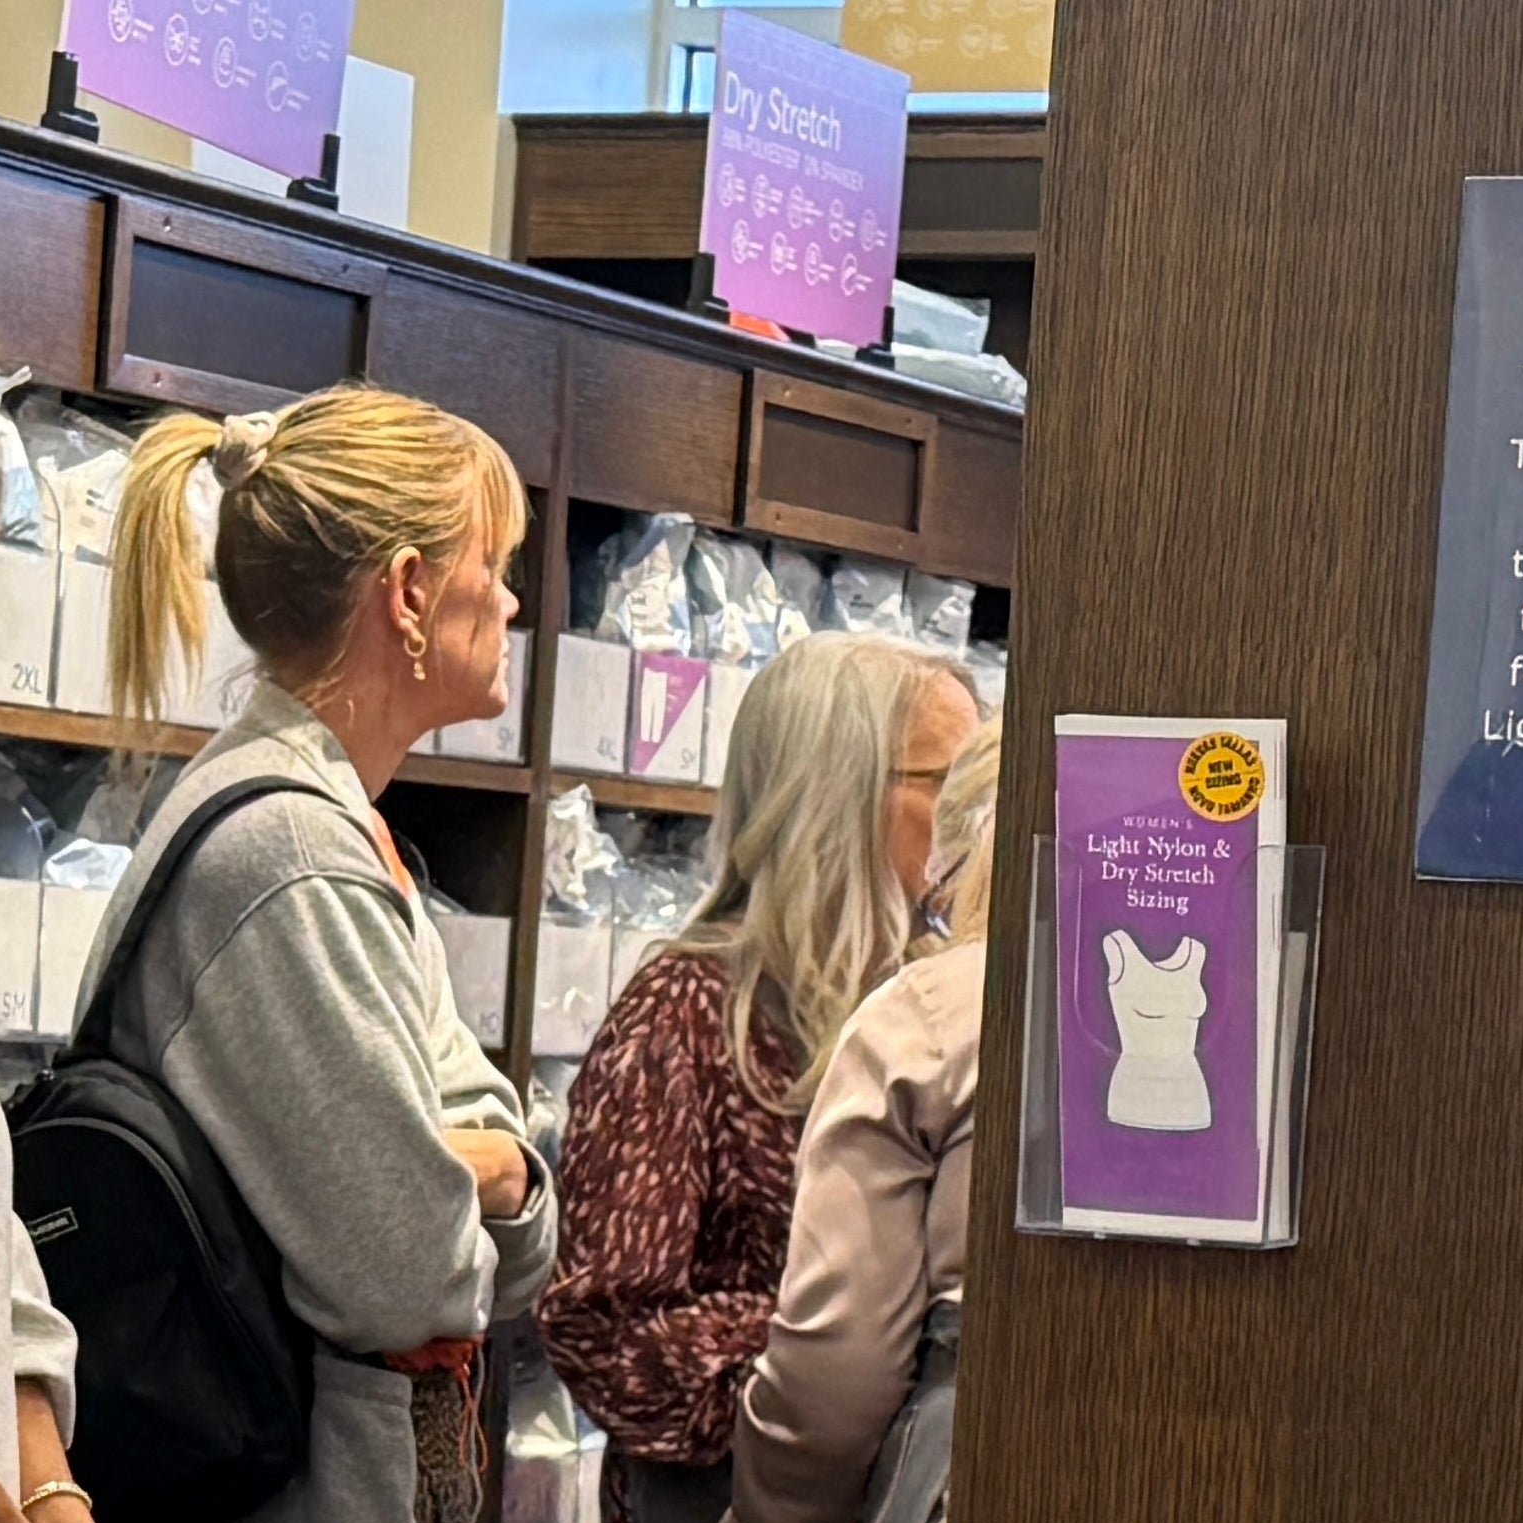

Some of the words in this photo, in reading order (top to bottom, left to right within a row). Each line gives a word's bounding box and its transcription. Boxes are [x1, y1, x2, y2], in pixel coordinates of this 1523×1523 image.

[724, 70, 763, 132] Dry
[767, 86, 841, 152] Stretch
[10, 662, 44, 696] 2XL
[1123, 816, 1194, 830] WOMEN'S
[1087, 834, 1140, 860] Light
[1147, 836, 1206, 861] Nylon
[1212, 838, 1231, 858] &
[1101, 861, 1139, 886] Dry
[1144, 863, 1215, 885] Stretch
[1126, 888, 1190, 916] Sizing
[1, 990, 26, 1020] SM
